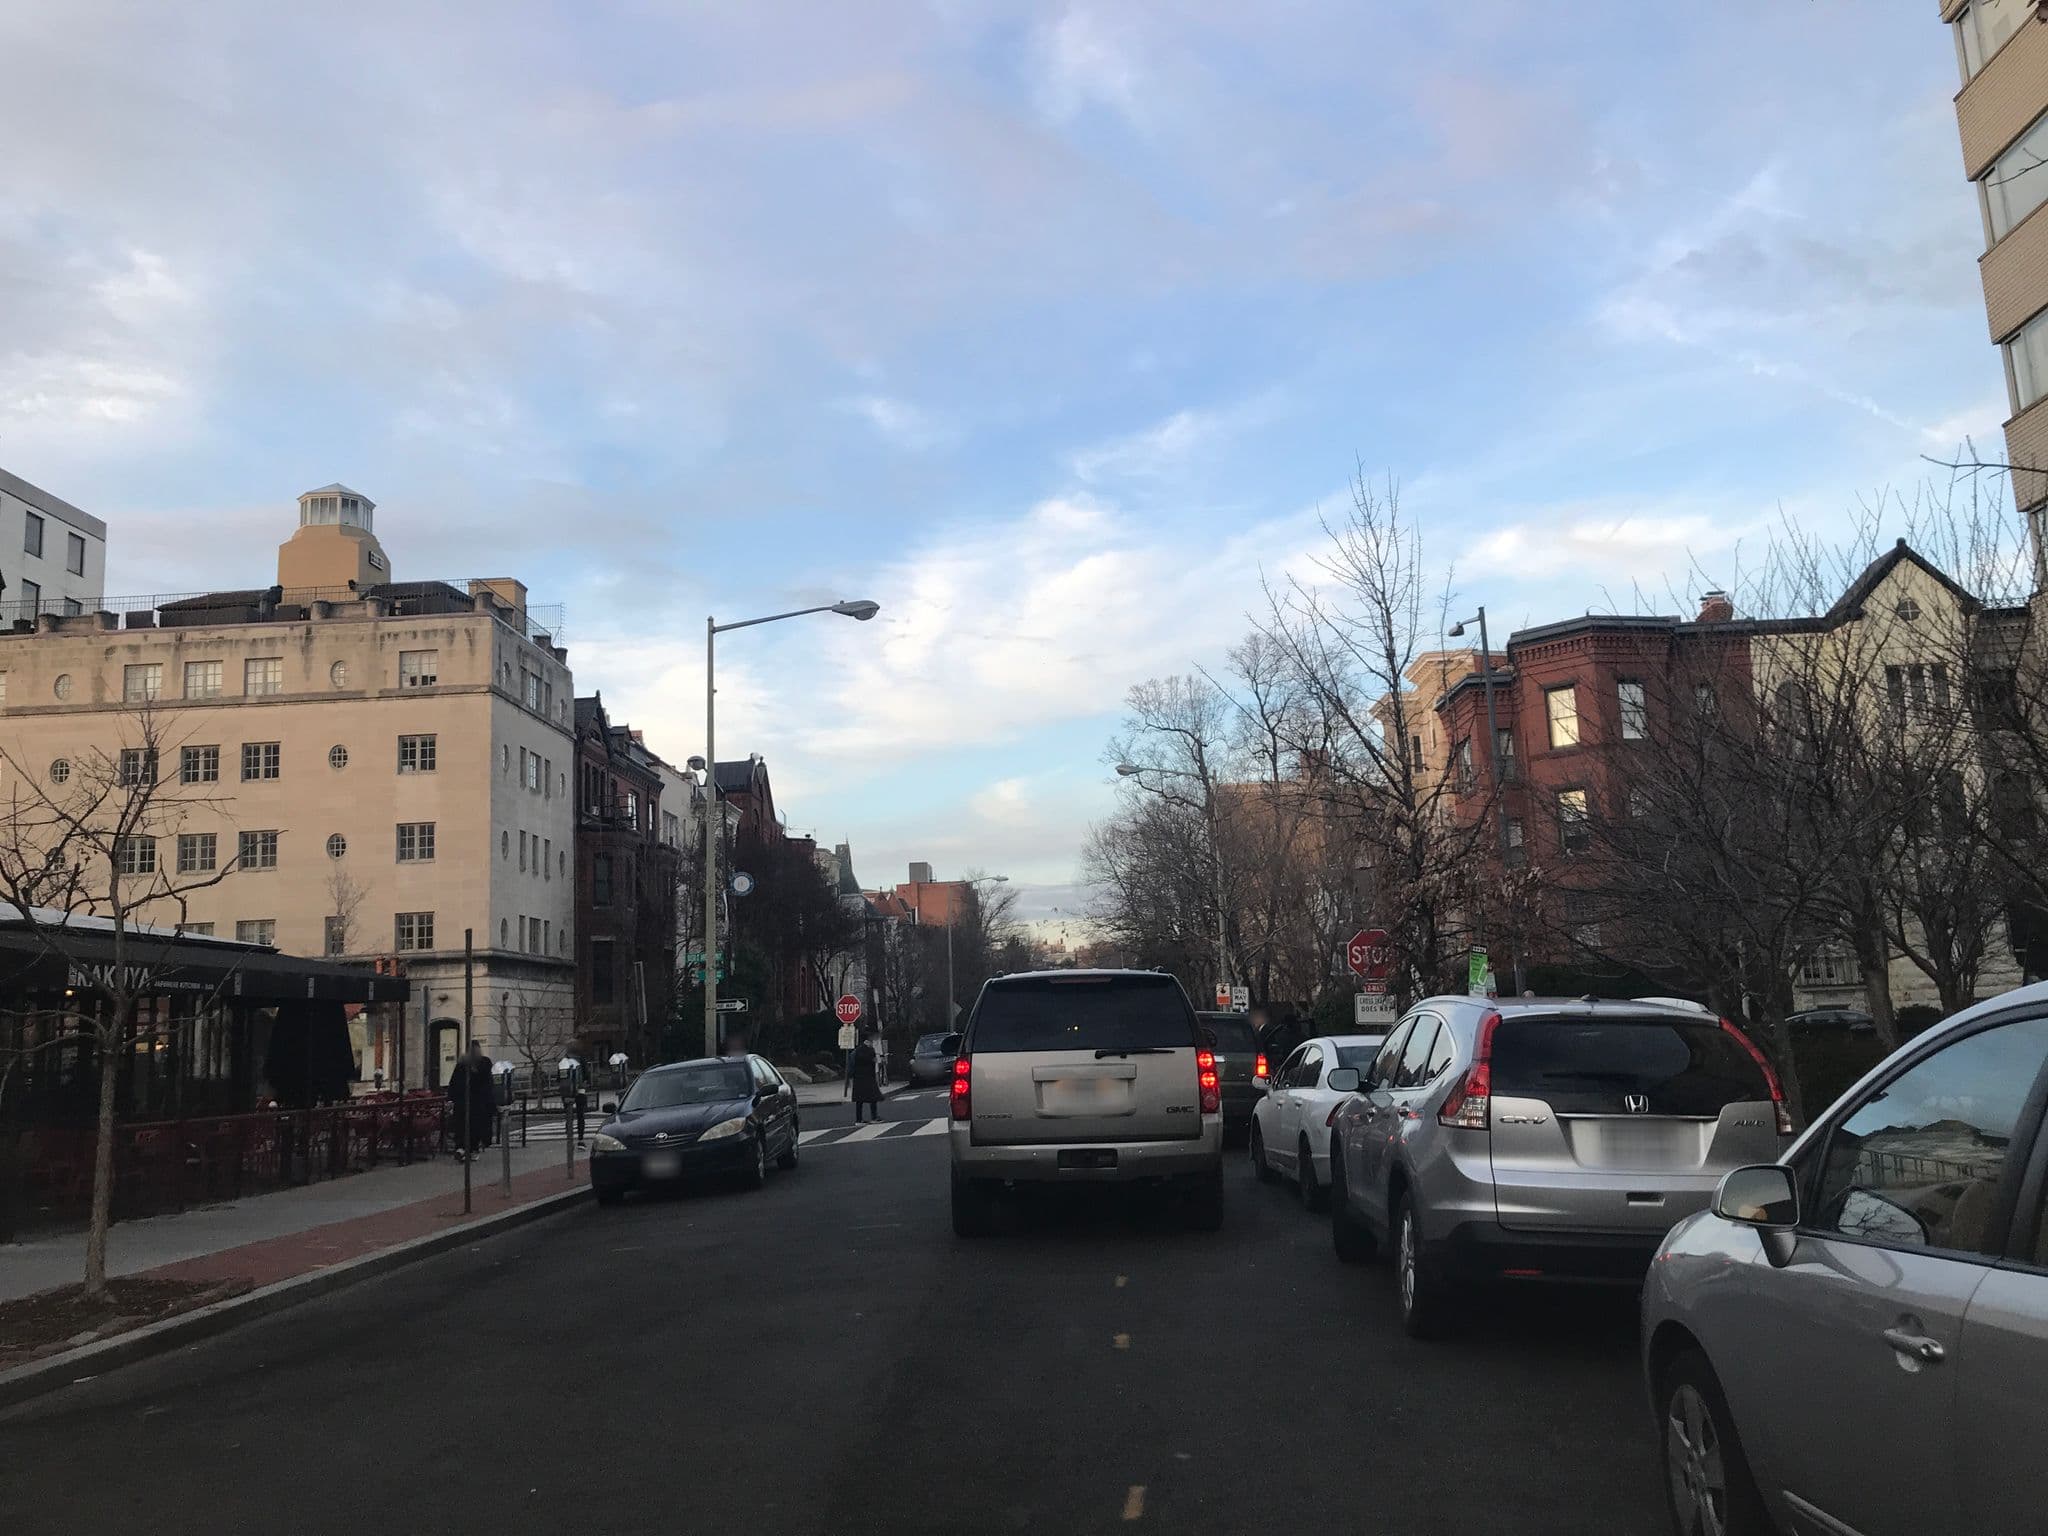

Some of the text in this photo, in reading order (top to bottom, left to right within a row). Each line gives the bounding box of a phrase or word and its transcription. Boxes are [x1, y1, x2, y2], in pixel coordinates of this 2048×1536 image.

[838, 1003, 860, 1015] STOP
[1361, 1005, 1378, 1013] DOES
[1166, 1105, 1195, 1114] GMC
[1499, 1115, 1548, 1125] CR-V
[1732, 1119, 1766, 1128] AWD
